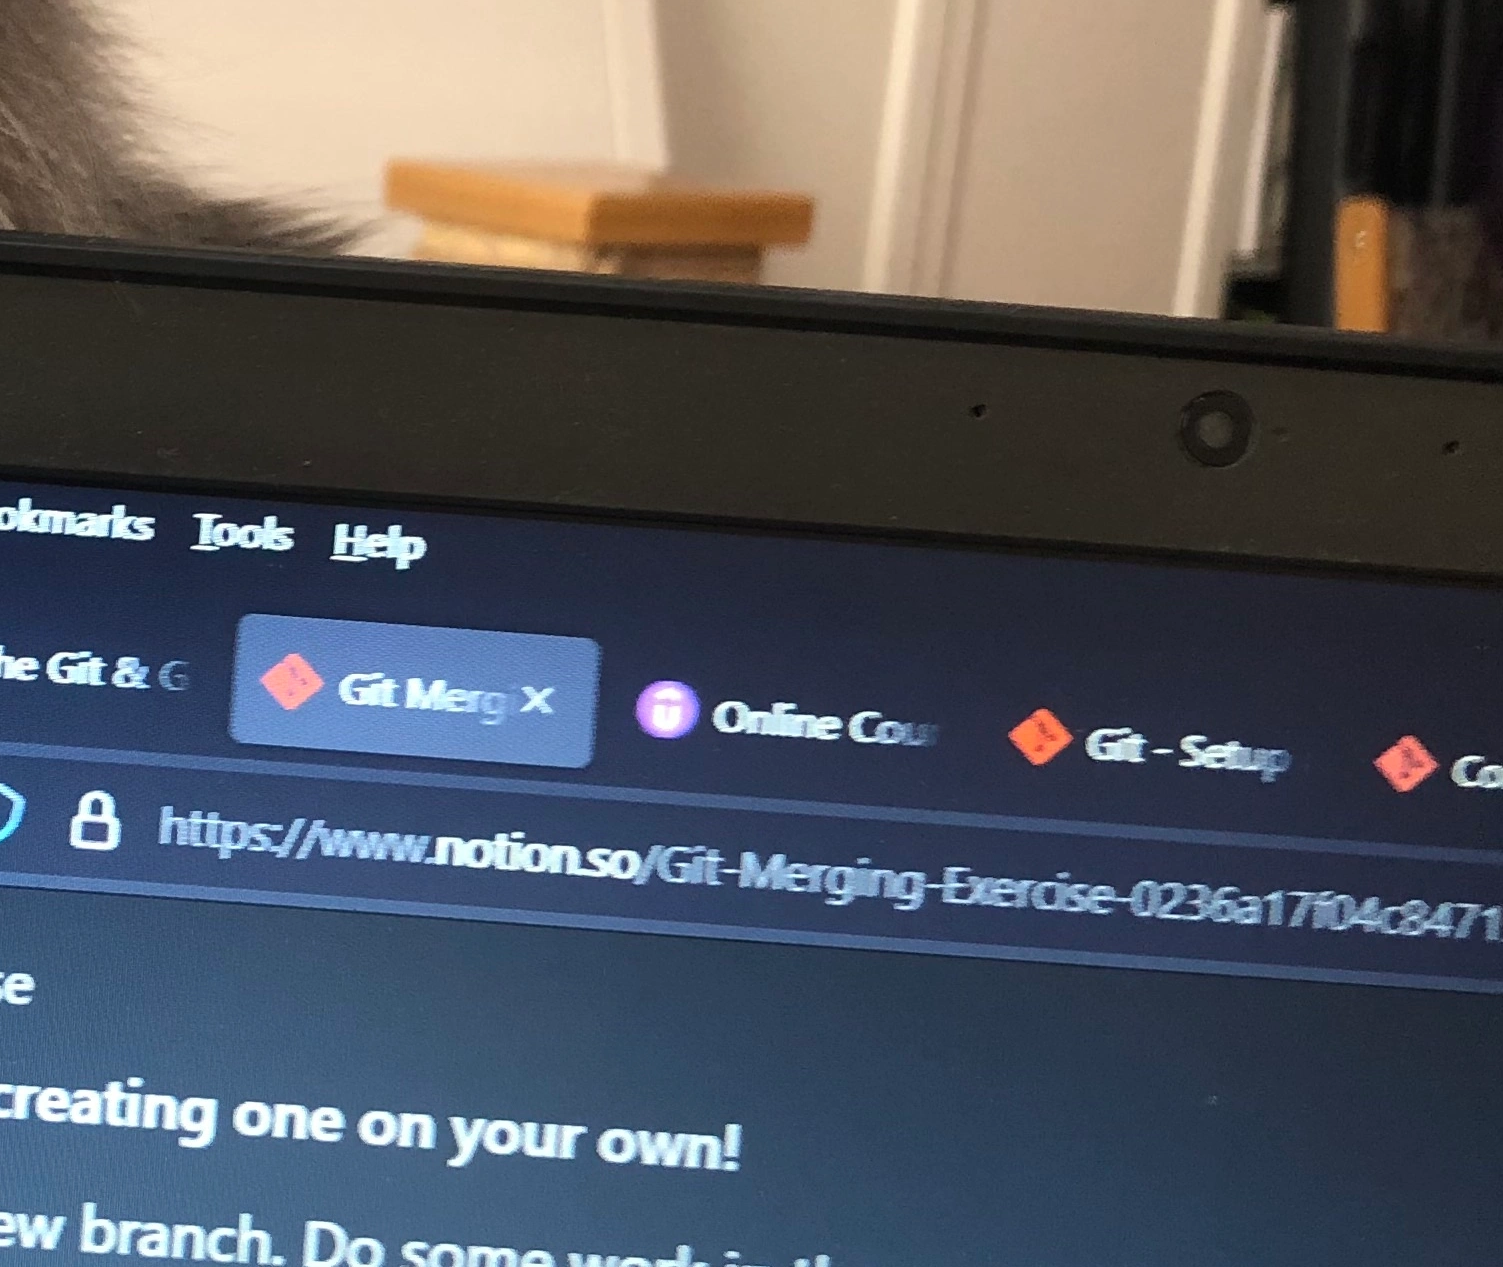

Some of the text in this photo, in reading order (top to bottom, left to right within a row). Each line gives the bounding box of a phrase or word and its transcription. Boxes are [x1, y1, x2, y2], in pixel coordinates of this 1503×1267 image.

[191, 512, 295, 553] Tools
[330, 523, 428, 570] Help
[46, 651, 108, 686] Git
[111, 656, 152, 690] &
[338, 672, 508, 725] Git Merg
[712, 700, 844, 740] Online
[1085, 727, 1149, 763] Git
[1178, 735, 1293, 784] Setup
[158, 806, 1503, 942] https://www.notion.so/Git-Merging-Exercise-0236a17f04c8471
[232, 1098, 346, 1144] one
[357, 1107, 436, 1150] on
[446, 1113, 588, 1167] your
[597, 1122, 743, 1172] own!
[80, 1201, 287, 1266] branch.
[302, 1220, 387, 1267] Do
